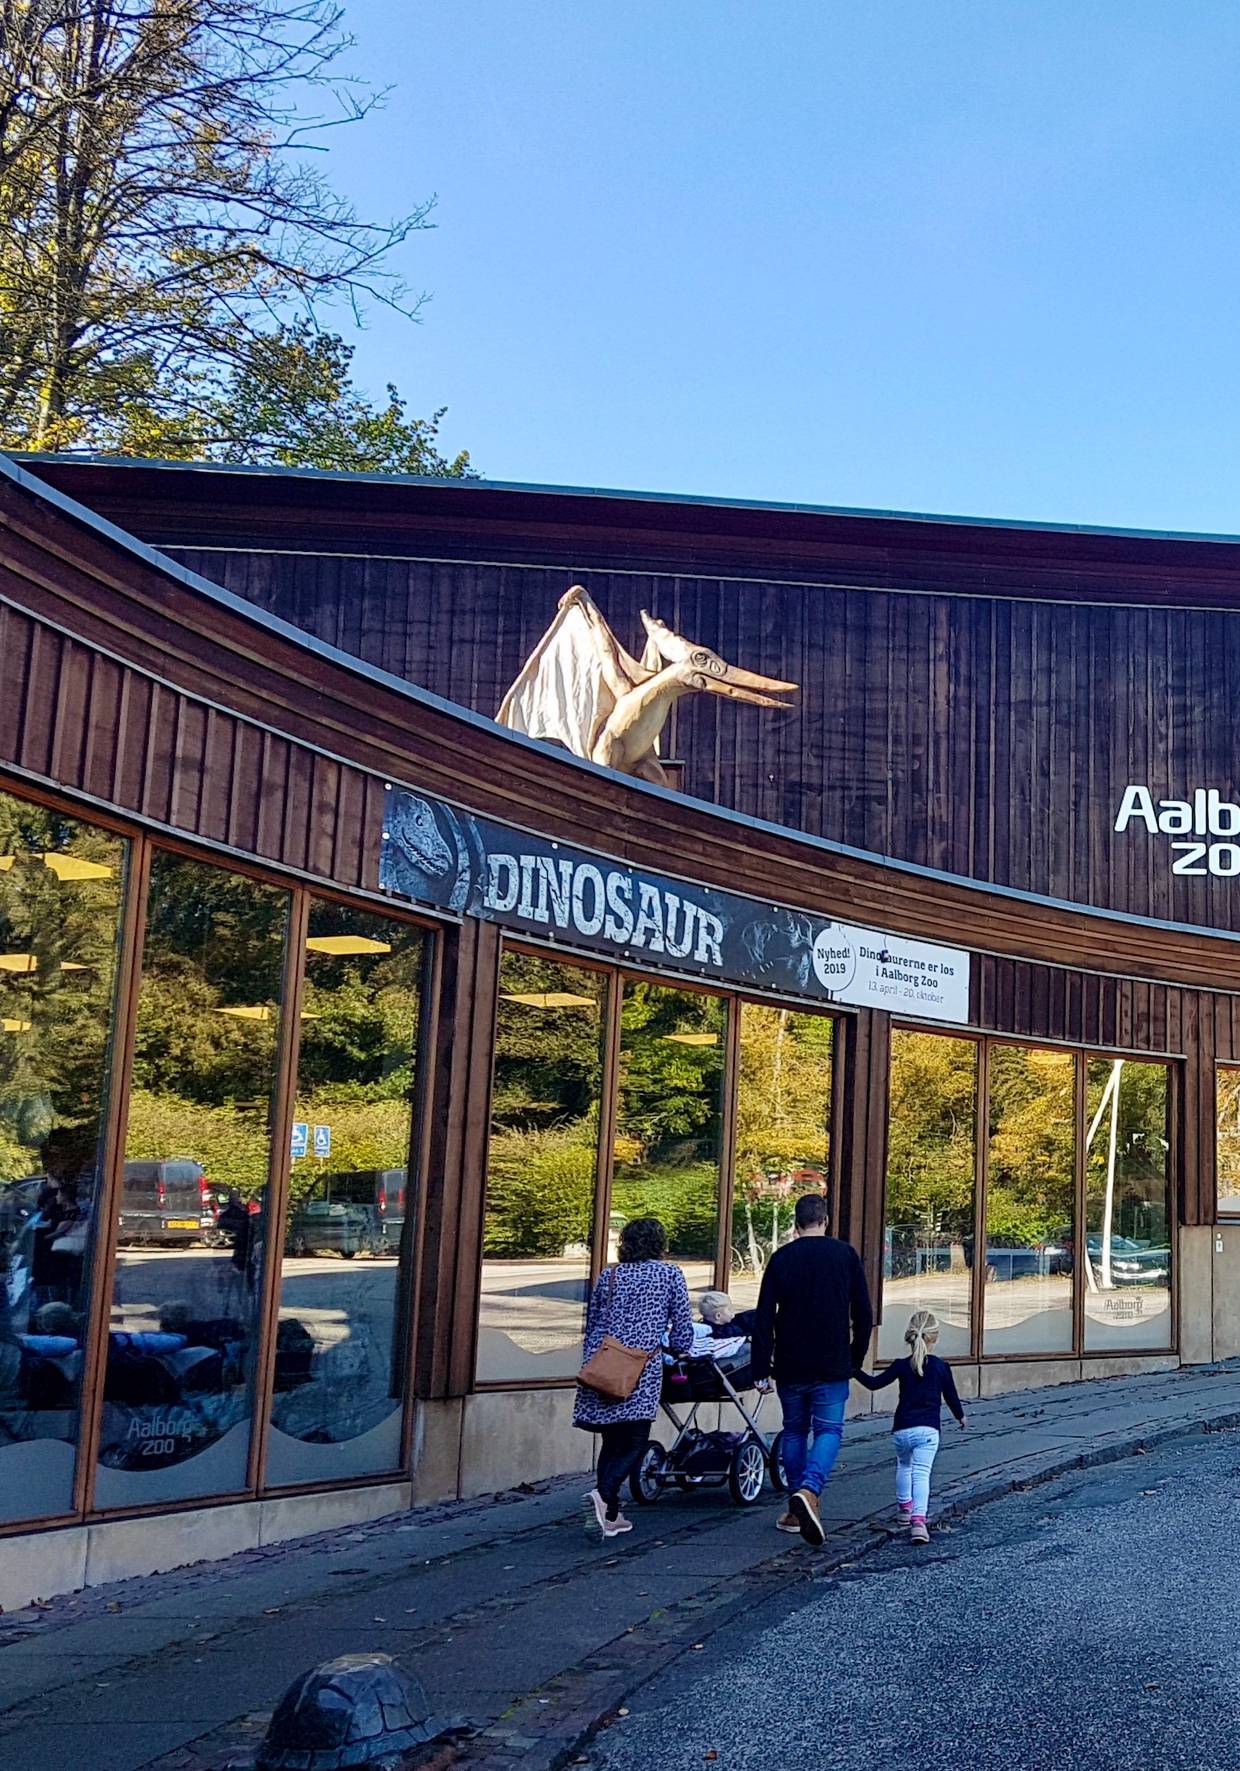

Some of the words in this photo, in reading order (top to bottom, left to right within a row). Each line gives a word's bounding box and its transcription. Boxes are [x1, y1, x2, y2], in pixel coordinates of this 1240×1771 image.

[483, 853, 724, 967] DINOSAUR
[817, 947, 850, 962] Nyhed!
[859, 946, 926, 970] Dinoaurerne
[928, 962, 938, 972] er
[824, 962, 846, 975] 2019
[875, 965, 879, 976] i
[881, 967, 919, 987] Aalborg
[921, 975, 938, 988] Zoo
[880, 984, 898, 996] april
[127, 1416, 193, 1443] Aalborg
